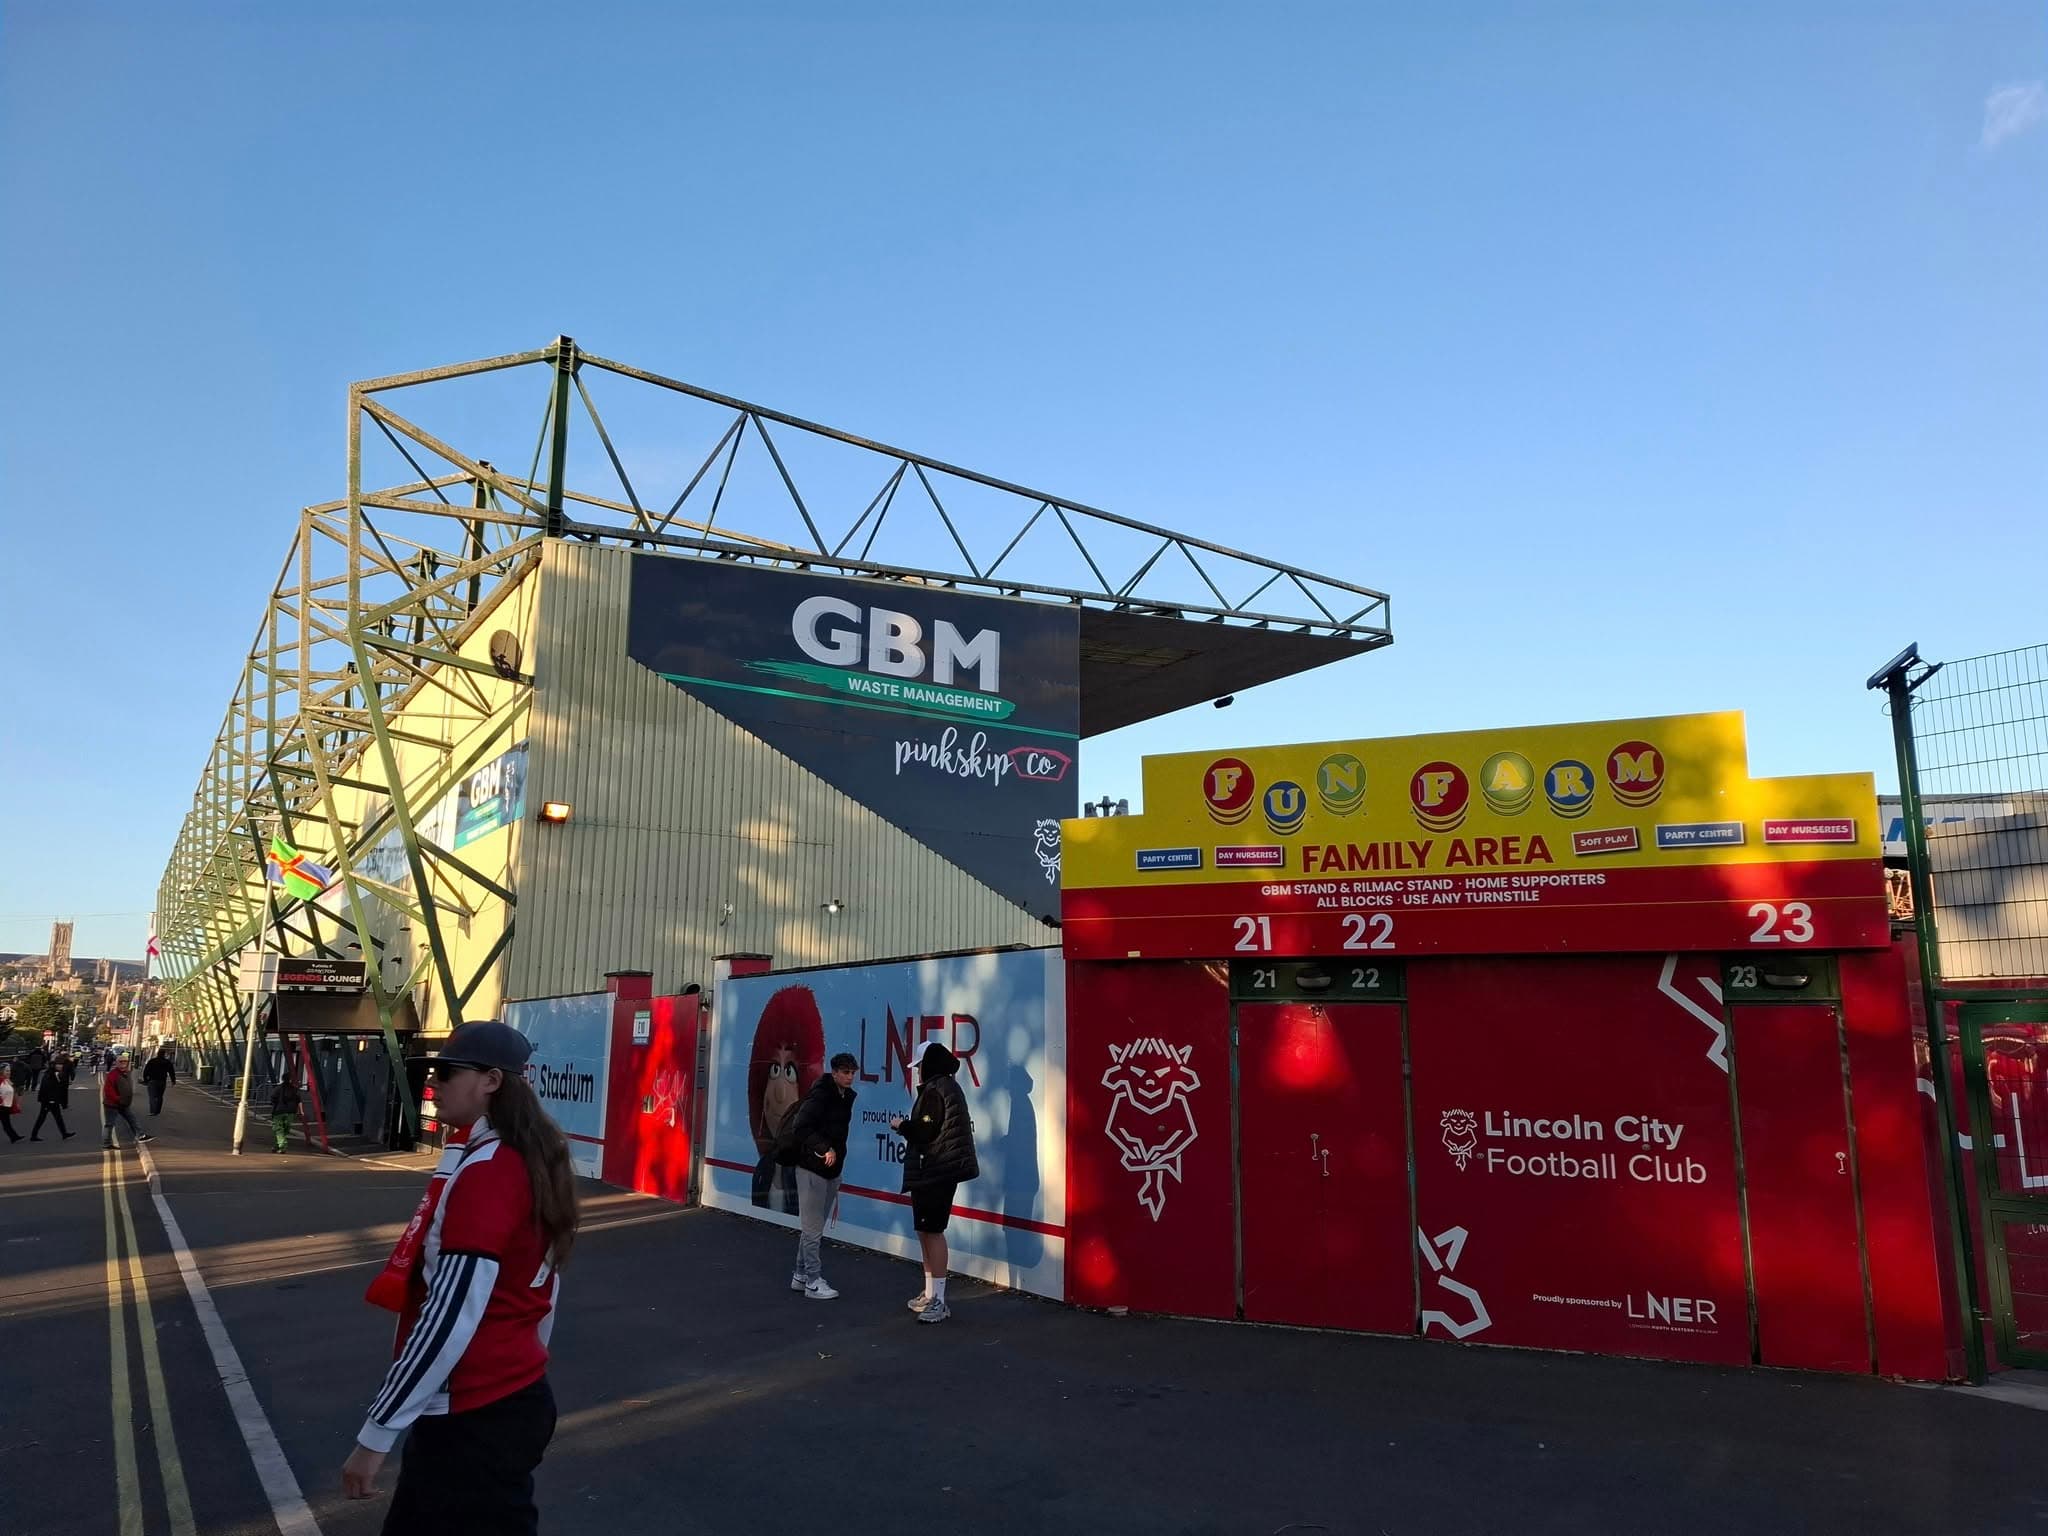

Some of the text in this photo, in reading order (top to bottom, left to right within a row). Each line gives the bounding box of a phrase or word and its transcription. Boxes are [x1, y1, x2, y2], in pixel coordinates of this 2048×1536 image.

[791, 595, 1000, 693] GBM
[848, 677, 1002, 713] WASTE MANAGEMENT
[896, 727, 1057, 787] pinkskip co
[470, 757, 502, 808] GBM
[1420, 751, 1657, 806] FARM
[1580, 835, 1629, 847] SOFT PLAY
[1665, 829, 1734, 840] PARTY CENTRE
[1768, 825, 1849, 835] DAY NURSERIES
[1142, 854, 1193, 864] PARTY CENTRE
[1218, 851, 1279, 860] DAY NURSERIES
[1302, 835, 1554, 873] FAMILY AREA
[1261, 873, 1606, 896] GBM STAND & RILMAC STAND HOME SUPPORTERS
[1317, 890, 1540, 908] ALL BLOCKS USE ANY TURNSTILE
[1233, 913, 1396, 952] 21 22
[1748, 902, 1815, 943] 23
[279, 973, 362, 983] LEGENDS LOUNGE
[1253, 968, 1380, 988] 21 22
[1730, 965, 1758, 988] 23
[539, 1063, 594, 1104] Stadium
[862, 1108, 887, 1124] proud
[1485, 1110, 1684, 1150] Lincoln City
[876, 1133, 906, 1164] The
[1487, 1148, 1707, 1184] Football Club
[1533, 1293, 1623, 1309] Proudly sponsored by
[1627, 1290, 1717, 1325] LNER
